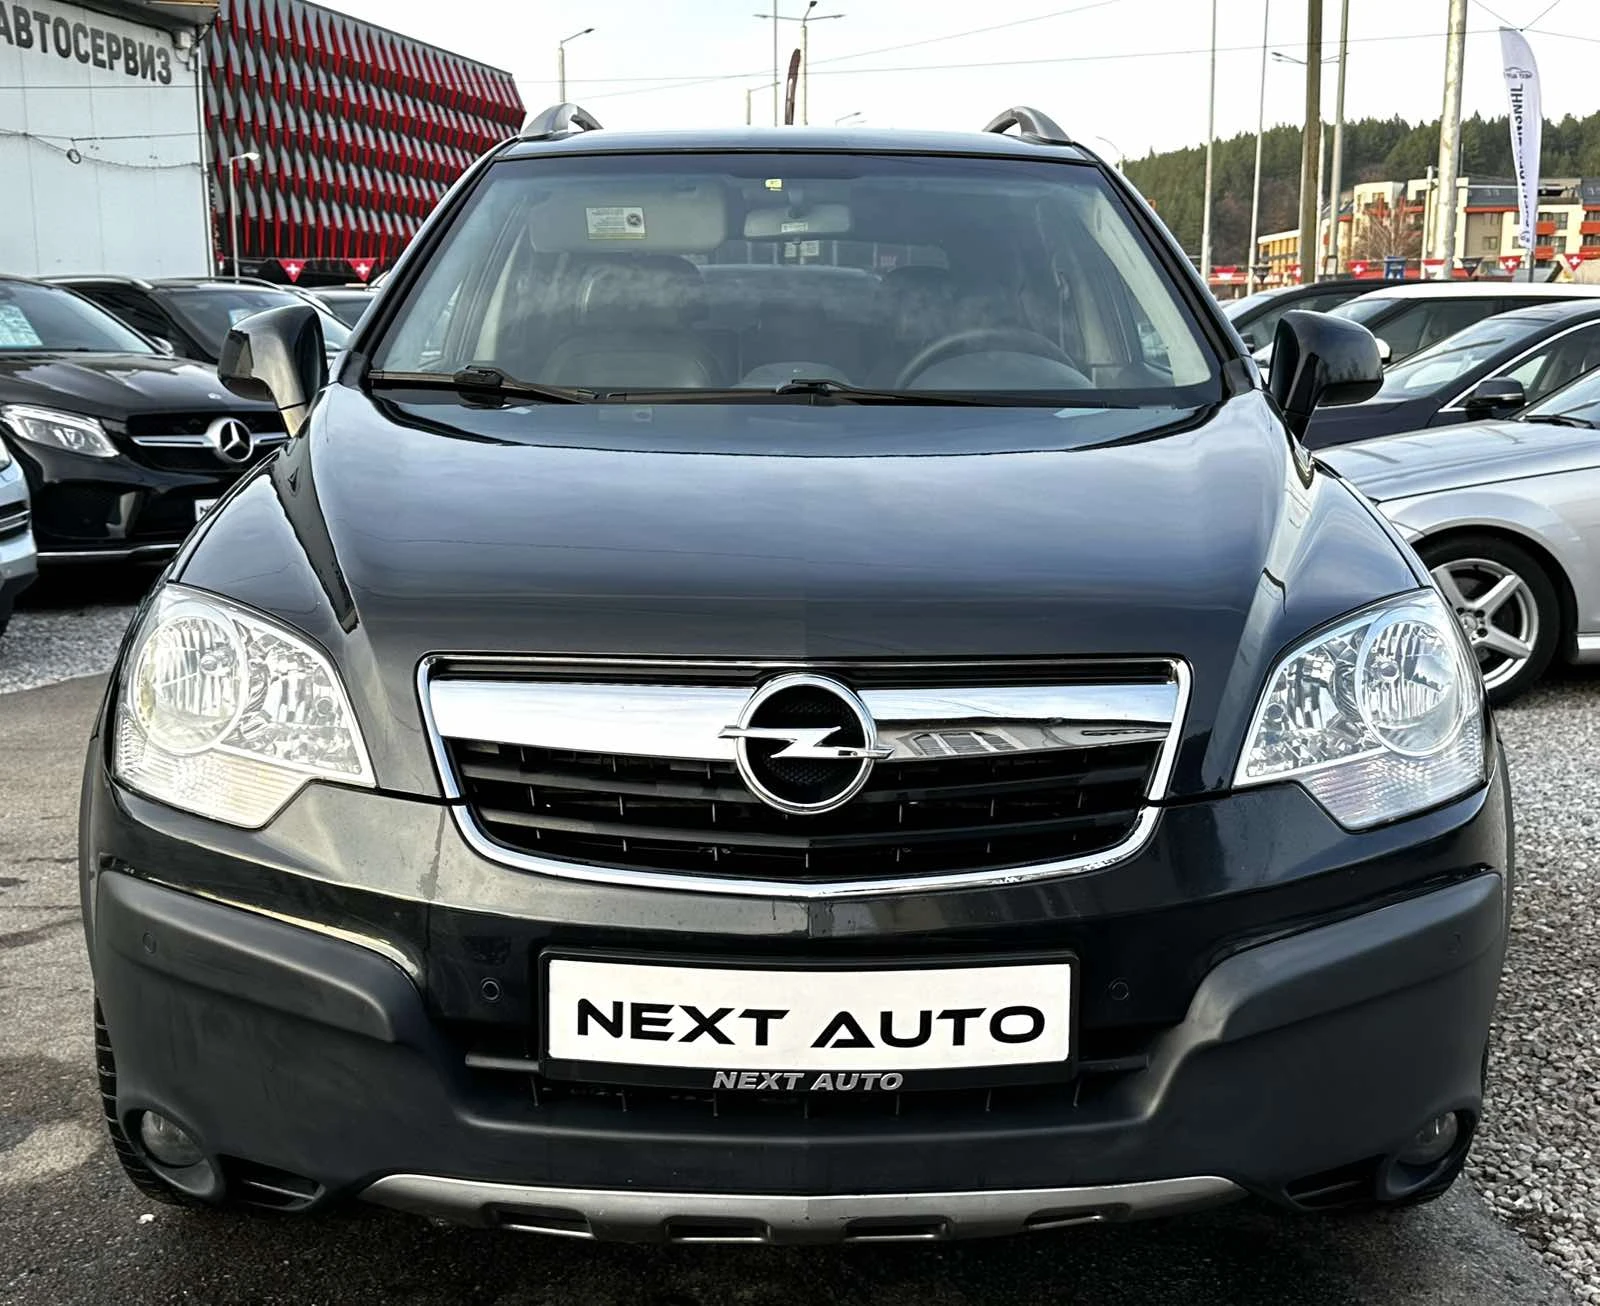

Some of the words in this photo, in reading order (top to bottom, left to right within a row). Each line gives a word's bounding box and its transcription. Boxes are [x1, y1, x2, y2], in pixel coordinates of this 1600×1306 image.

[0, 0, 172, 85] АВТОСЕРВИЗ
[577, 998, 790, 1046] NEXT
[810, 1005, 1046, 1048] AUTO
[713, 1071, 806, 1091] NEXT
[809, 1073, 904, 1091] AUTO
